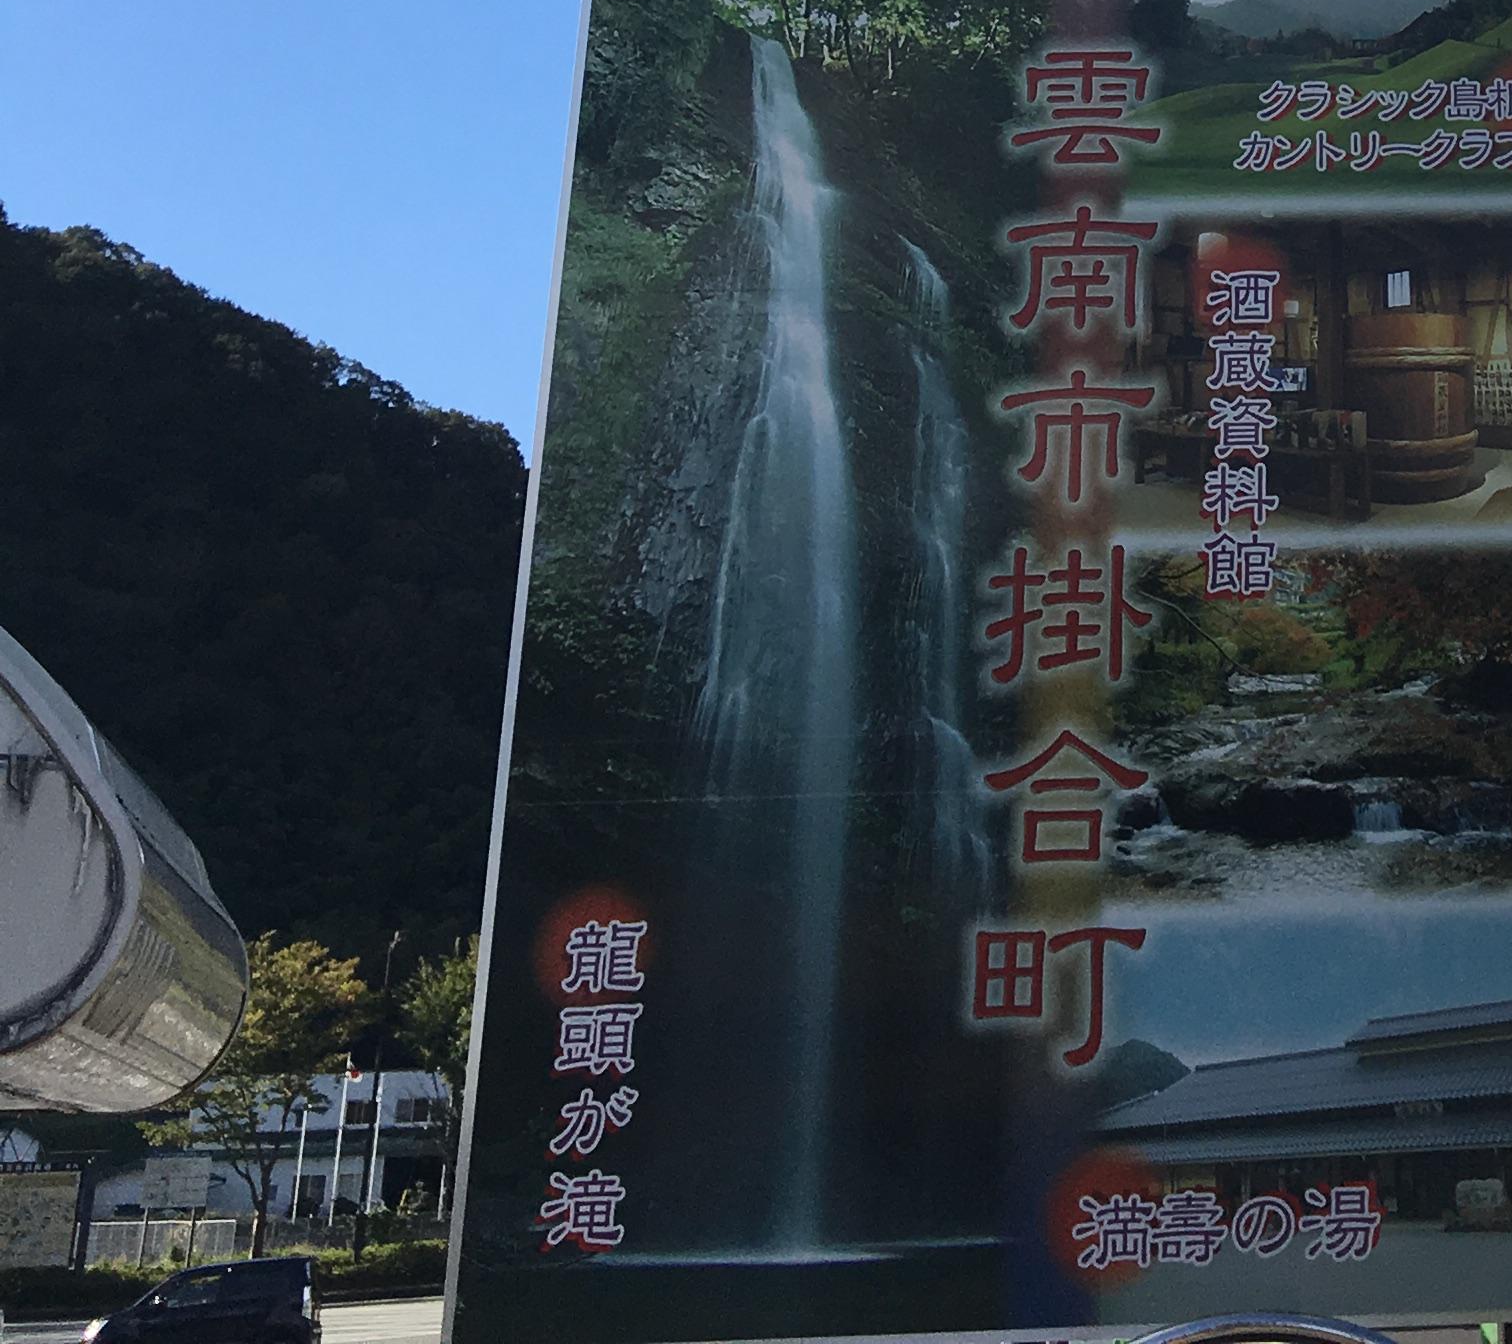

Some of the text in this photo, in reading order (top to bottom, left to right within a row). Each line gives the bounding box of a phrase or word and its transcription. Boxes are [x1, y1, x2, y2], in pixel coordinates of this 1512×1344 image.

[971, 50, 1161, 1068] 雲南市掛合町
[1201, 269, 1280, 595] 酒蔵資料館
[538, 919, 648, 1249] 龍頭が滝
[1071, 1185, 1383, 1270] 満壽の湯
